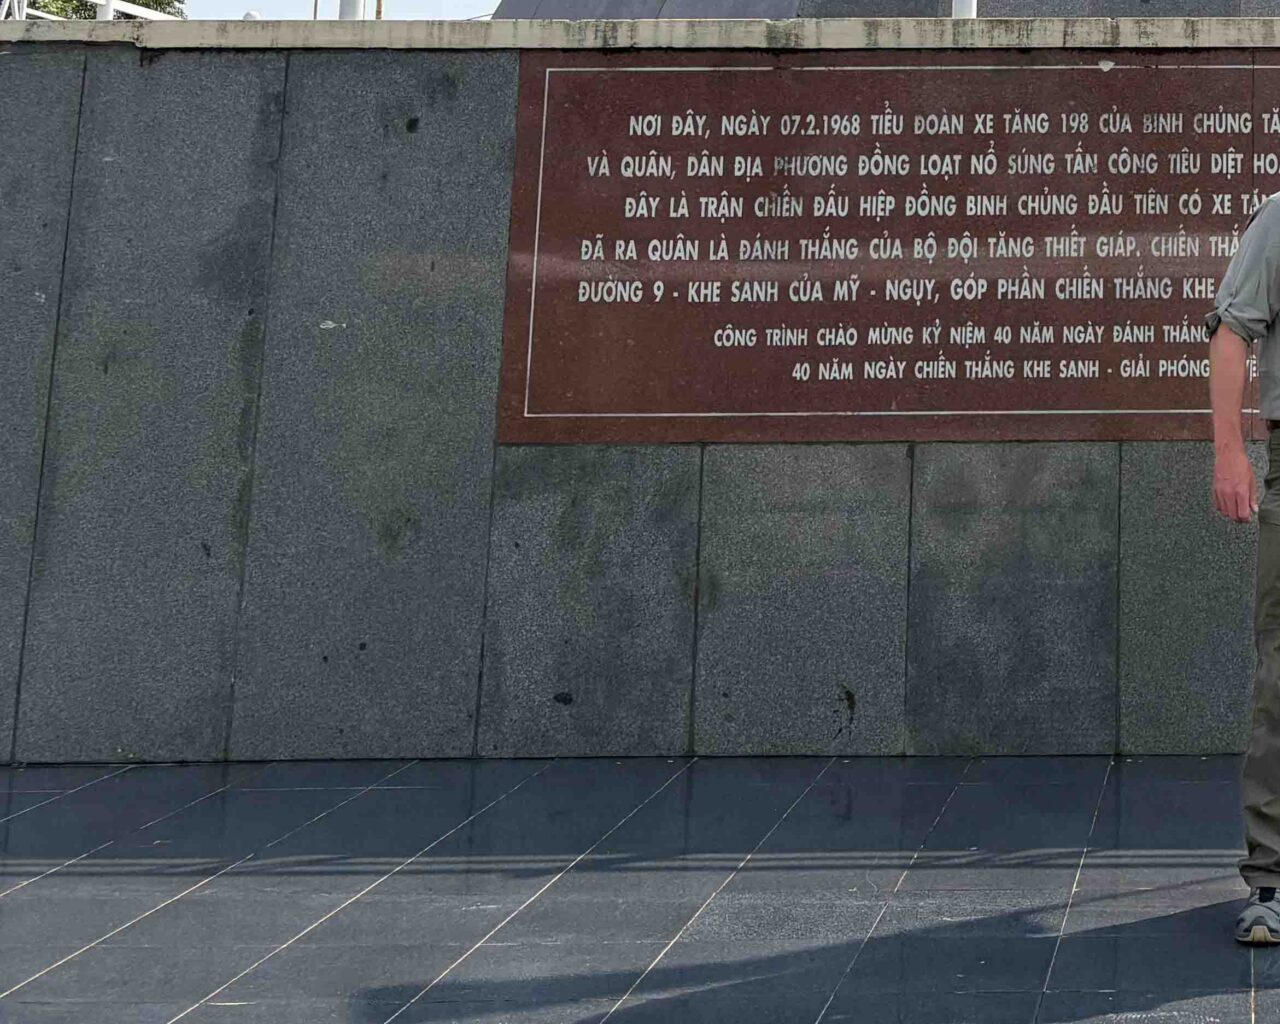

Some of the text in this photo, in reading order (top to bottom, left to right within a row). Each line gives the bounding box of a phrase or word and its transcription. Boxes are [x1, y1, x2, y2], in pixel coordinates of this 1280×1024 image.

[628, 114, 662, 136] NƠI
[671, 107, 711, 141] ĐÂY,
[720, 107, 771, 136] NGÀY
[780, 114, 861, 136] 07.2.1968
[870, 101, 904, 135] TIỂU
[914, 106, 964, 135] ĐOÀN
[973, 113, 994, 135] XE
[1002, 106, 1050, 135] TĂNG
[1060, 113, 1089, 135] 198
[1099, 106, 1133, 134] CỦA
[1142, 113, 1184, 134] BINH
[1193, 106, 1253, 134] CHỦNG
[586, 148, 610, 177] VÀ
[620, 148, 677, 181] QUÂN,
[686, 148, 724, 177] DÂN
[734, 155, 764, 181] ĐỊA
[773, 154, 849, 176] PHƯƠNG
[857, 141, 911, 176] ĐỒNG
[920, 154, 963, 180] LOẠT
[969, 141, 998, 175] NỔ
[1007, 146, 1056, 175] SÚNG
[1064, 140, 1098, 175] TẤN
[1107, 146, 1159, 175] CÔNG
[1167, 146, 1201, 175] TIÊU
[1210, 146, 1244, 179] DIỆT
[624, 189, 661, 218] ĐÂY
[669, 189, 690, 218] LÀ
[699, 188, 744, 222] TRẬN
[753, 182, 803, 217] CHIẾN
[813, 182, 849, 217] ĐẤU
[859, 188, 896, 221] HIỆP
[904, 181, 957, 216] ĐỒNG
[965, 194, 1008, 216] BINH
[1017, 187, 1078, 216] CHỦNG
[1087, 180, 1124, 215] ĐẦU
[1133, 186, 1169, 215] TIÊN
[1178, 186, 1202, 215] CÓ
[1211, 193, 1232, 215] XE
[580, 232, 605, 261] ĐÃ
[614, 239, 638, 261] RA
[647, 232, 700, 260] QUÂN
[709, 231, 729, 260] LÀ
[738, 231, 790, 260] ĐÁNH
[799, 225, 859, 259] THẮNG
[869, 231, 904, 259] CỦA
[913, 230, 938, 263] BỘ
[947, 230, 978, 263] ĐỘI
[987, 230, 1035, 258] TĂNG
[1044, 224, 1087, 258] THIẾT
[1150, 223, 1200, 257] CHIẾN
[1208, 223, 1240, 257] THẮ
[577, 273, 644, 302] ĐƯỜNG
[653, 280, 665, 302] 9
[687, 280, 721, 302] KHE
[730, 280, 779, 302] SANH
[788, 272, 824, 302] CỦA
[832, 272, 861, 301] MỸ
[885, 279, 940, 306] NGỤY,
[950, 272, 988, 301] GÓP
[996, 265, 1045, 301] PHẦN
[1054, 265, 1104, 300] CHIẾN
[1113, 265, 1173, 300] THẮNG
[1182, 278, 1216, 300] KHE
[713, 321, 758, 347] CÔNG
[765, 321, 809, 346] TRÌNH
[815, 321, 858, 346] CHÀO
[867, 320, 914, 346] MỪNG
[922, 320, 943, 345] KỶ
[949, 320, 986, 350] NIỆM
[993, 326, 1012, 345] 40
[1019, 319, 1055, 345] NĂM
[1062, 319, 1105, 344] NGÀY
[1112, 318, 1155, 344] ĐÁNH
[791, 362, 811, 381] 40
[817, 355, 854, 381] NĂM
[863, 354, 907, 380] NGÀY
[914, 348, 957, 380] CHIẾN
[964, 348, 1016, 380] THẮNG
[1023, 360, 1052, 379] KHE
[1058, 360, 1100, 379] SANH
[1119, 352, 1150, 378] GIẢI
[1158, 352, 1210, 378] PHÓNG
